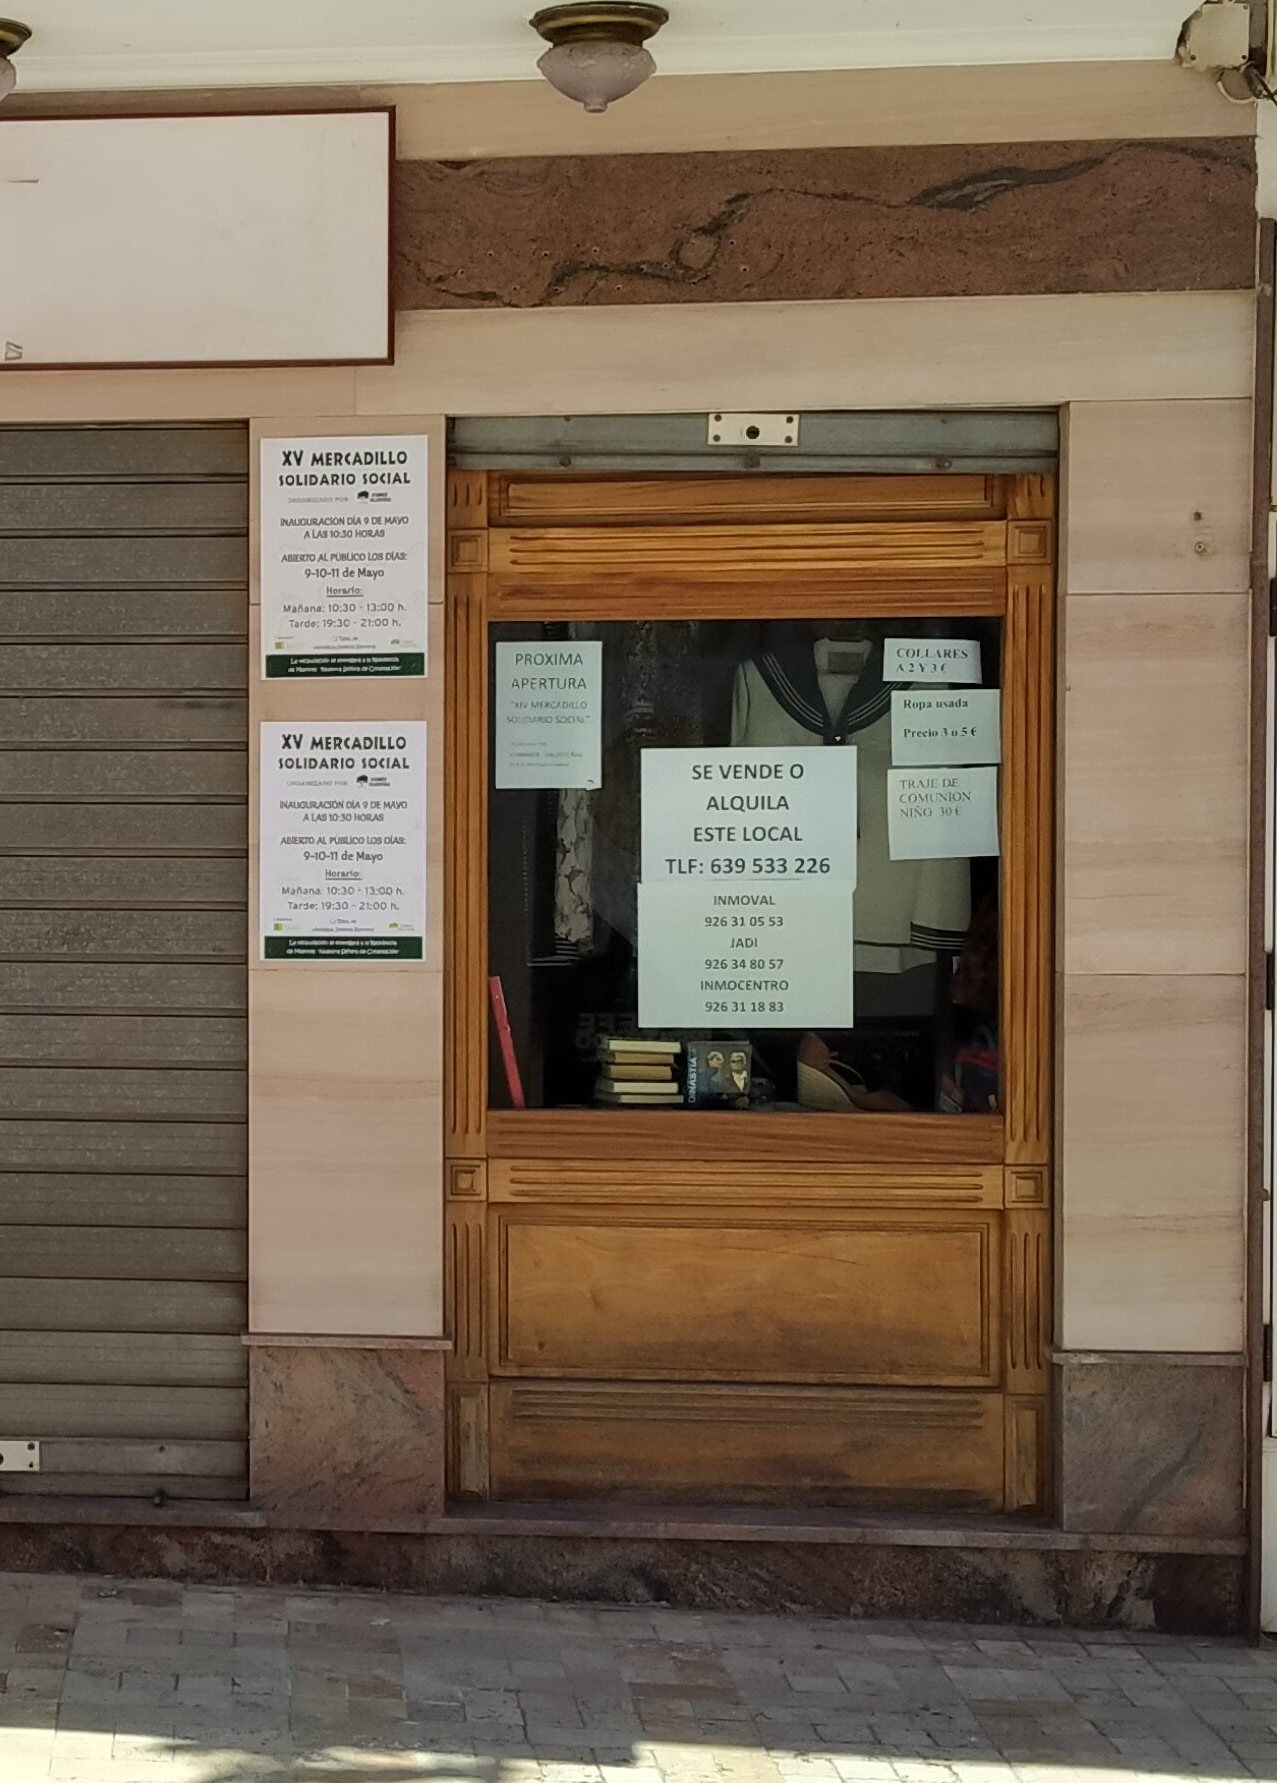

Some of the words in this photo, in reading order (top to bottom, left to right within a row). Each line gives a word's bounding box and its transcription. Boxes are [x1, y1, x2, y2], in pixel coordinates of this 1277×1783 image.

[282, 450, 303, 466] XV
[311, 451, 407, 466] MERCADILLO
[279, 474, 355, 486] SOLIDARIO
[363, 472, 410, 484] SOCIAL
[280, 517, 345, 526] INAUGURACIÓN
[346, 517, 361, 525] DÍA
[364, 517, 369, 525] 9
[372, 517, 383, 525] DE
[384, 516, 408, 525] MAYO
[304, 530, 310, 538] A
[312, 530, 328, 538] LAS
[330, 530, 353, 538] 10:30
[355, 529, 385, 538] HORAS
[281, 554, 315, 562] ABIERTO
[318, 554, 328, 562] AL
[330, 552, 366, 561] PÚBLICO
[367, 552, 383, 561] LOS
[385, 551, 407, 561] DÍAS:
[304, 569, 339, 578] 9-10-11
[342, 568, 354, 577] de
[358, 568, 384, 580] Mayo
[326, 586, 363, 597] Horario:
[283, 604, 325, 613] Mañana:
[328, 604, 356, 612] 10:30
[366, 603, 394, 612] 13:00
[397, 603, 406, 611] h.
[289, 620, 320, 628] Tarde:
[323, 619, 350, 628] 19:30
[361, 619, 388, 627] 21:00
[392, 619, 401, 627] h.
[516, 653, 583, 665] PROXIMA
[896, 648, 968, 659] COLLARES
[896, 664, 904, 672] A
[909, 664, 914, 672] 2
[919, 664, 927, 673] Y
[931, 664, 937, 673] 3
[511, 678, 586, 689] APERTURA
[531, 701, 587, 709] MERCADILLO
[903, 699, 931, 711] Ropa
[936, 699, 968, 708] usada
[903, 728, 938, 738] Precio
[941, 728, 948, 736] 3
[962, 727, 968, 736] 5
[971, 727, 976, 736] €
[281, 734, 303, 750] XV
[310, 736, 406, 750] MERCADILLO
[279, 758, 354, 769] SOLIDARIO
[362, 758, 409, 769] SOCIAL
[692, 765, 712, 780] SE
[719, 764, 783, 779] VENDE
[790, 764, 803, 779] O
[899, 780, 939, 789] TRAJE
[943, 779, 958, 787] DE
[279, 800, 344, 809] INAUGURACIÓN
[346, 800, 361, 809] DÍA
[371, 801, 382, 809] DE
[384, 801, 407, 809] MAYO
[706, 796, 789, 812] ALQUILA
[900, 805, 932, 818] NIÑO
[939, 807, 953, 816] 30
[955, 807, 962, 816] €
[303, 814, 309, 822] A
[311, 814, 327, 822] LAS
[329, 813, 352, 821] 10:30
[354, 813, 384, 821] HORAS
[280, 836, 315, 845] ABIERTO
[316, 836, 327, 845] AL
[329, 835, 365, 845] PÚBLICO
[367, 836, 382, 844] LOS
[384, 835, 406, 844] DÍAS:
[694, 827, 736, 842] ESTE
[743, 827, 803, 841] LOCAL
[303, 852, 338, 861] 9-10-11
[341, 851, 353, 860] de
[356, 851, 383, 863] Mayo
[665, 859, 704, 874] TLF:
[711, 859, 745, 874] 639
[752, 858, 787, 873] 533
[795, 858, 830, 873] 226
[325, 869, 362, 880] Horario:
[327, 887, 354, 895] 10:30
[365, 887, 393, 895] 13:00
[396, 887, 405, 895] h.
[288, 902, 318, 910] Tarde:
[322, 902, 349, 910] 19:30
[359, 902, 387, 910] 21:00
[390, 902, 399, 910] h.
[714, 896, 776, 905] INMOVAL
[705, 917, 727, 926] 926
[732, 917, 745, 926] 31
[750, 917, 764, 926] 05
[769, 916, 783, 926] 53
[730, 938, 757, 948] JADI
[705, 959, 728, 969] 926
[732, 959, 746, 969] 34
[750, 959, 765, 969] 80
[769, 959, 783, 969] 57
[701, 980, 789, 991] INMOCENTRO
[705, 1002, 728, 1012] 926
[732, 1002, 746, 1012] 31
[751, 1002, 765, 1012] 18
[769, 1002, 784, 1012] 83
